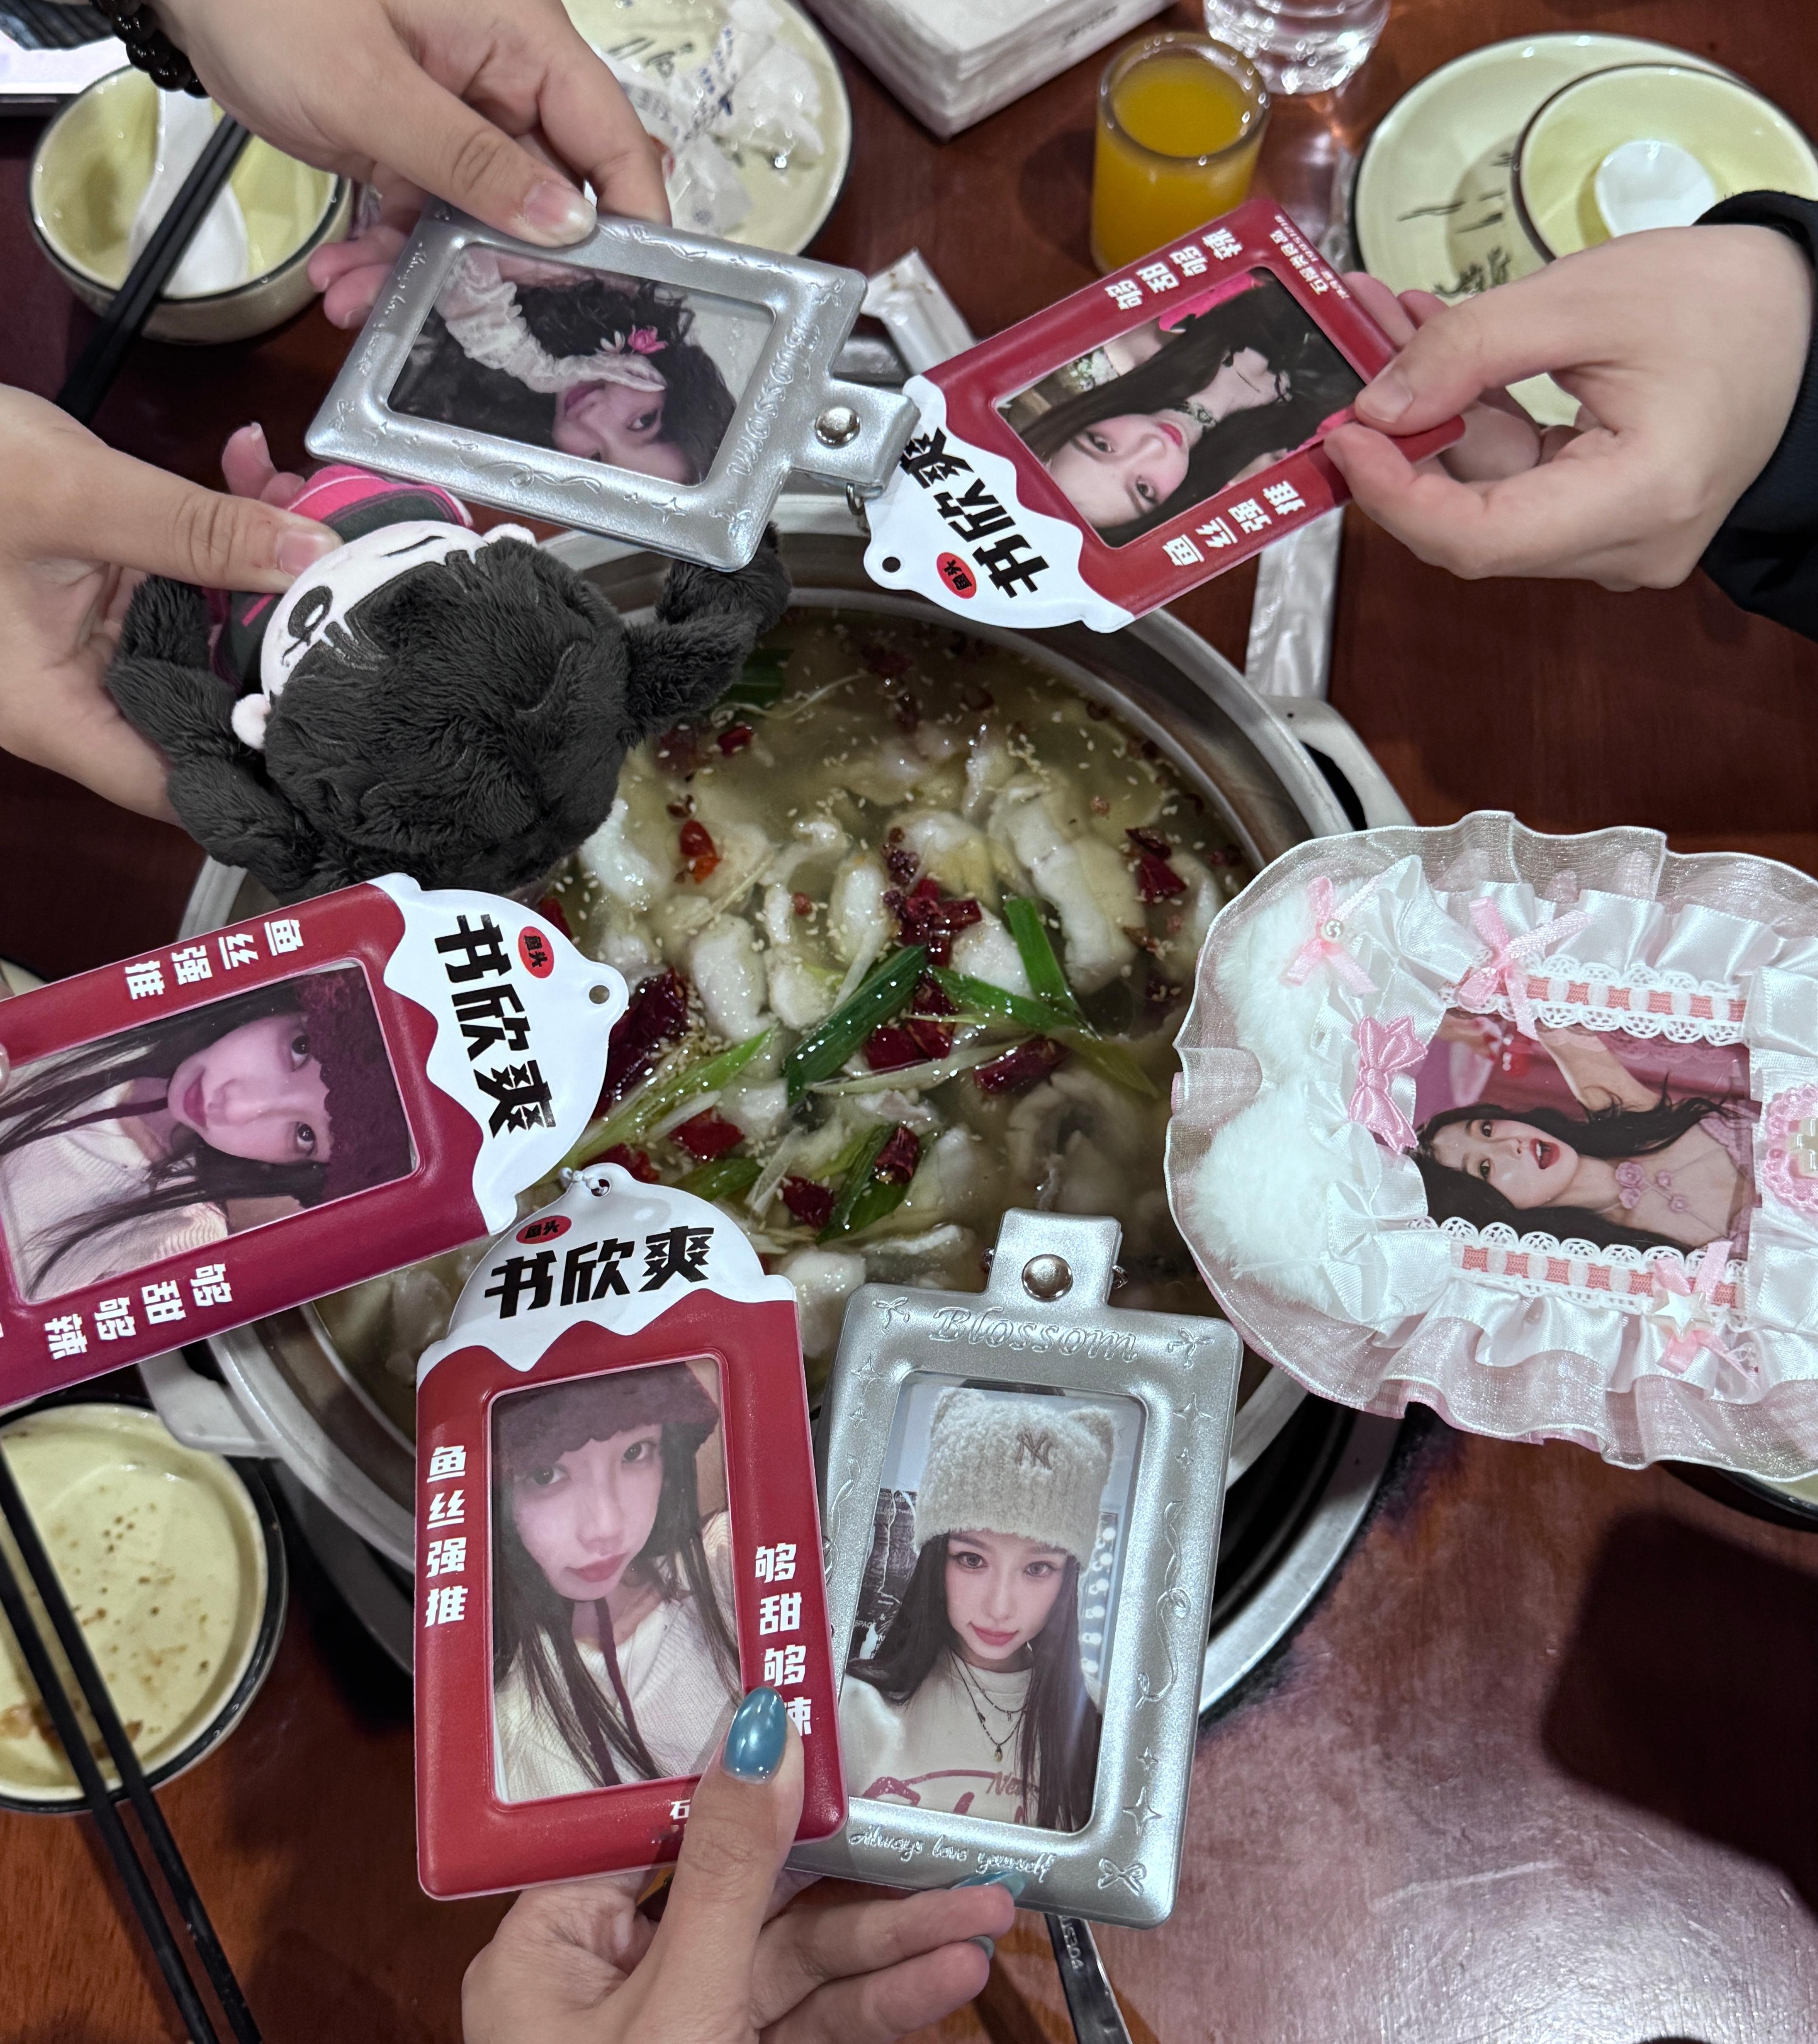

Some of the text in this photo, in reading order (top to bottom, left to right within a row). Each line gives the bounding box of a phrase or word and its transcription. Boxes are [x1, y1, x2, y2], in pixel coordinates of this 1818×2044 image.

[1105, 228, 1243, 310] 够甜够辣
[727, 318, 820, 476] Blossom
[900, 427, 1049, 598] 书欣爽
[1162, 480, 1305, 566] 鱼丝强推
[124, 919, 304, 1000] 鱼丝强推
[434, 914, 556, 1139] 书欣爽
[45, 1263, 232, 1359] 够甜够辣
[484, 1226, 714, 1319] 书欣爽
[929, 1306, 1138, 1363] Blossom
[1014, 1428, 1053, 1470] NY
[424, 1445, 468, 1628] 鱼丝强推
[850, 1824, 1057, 1883] Always love yourself
